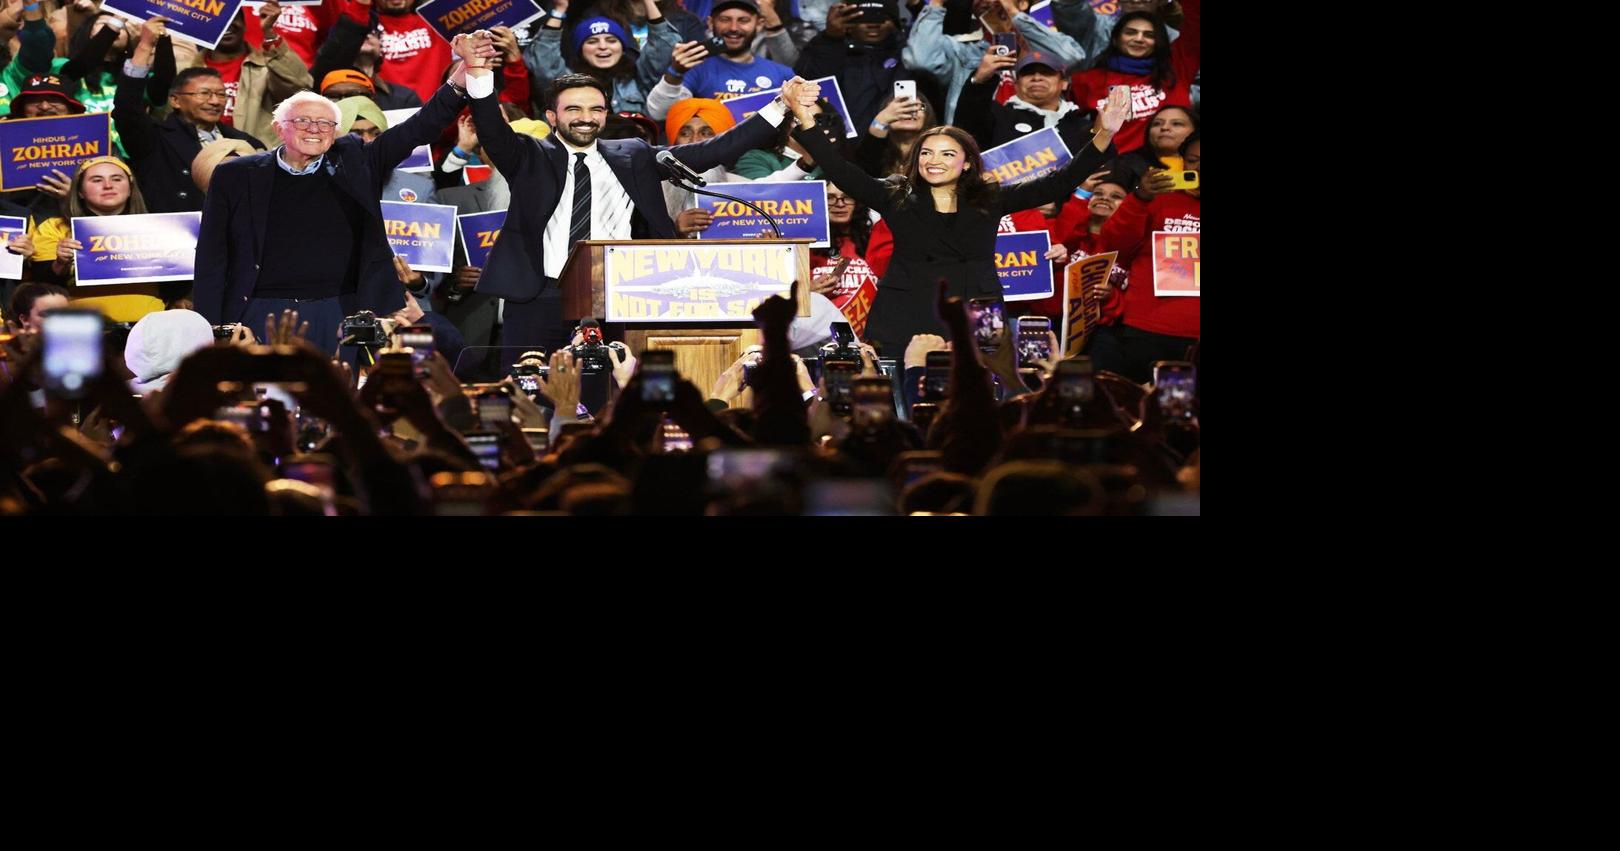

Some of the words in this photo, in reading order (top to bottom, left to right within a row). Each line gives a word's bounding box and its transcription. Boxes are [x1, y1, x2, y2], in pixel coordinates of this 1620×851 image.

[167, 2, 191, 16] YORK
[191, 11, 212, 23] CITY
[438, 0, 500, 30] ZOHRA
[495, 1, 513, 13] CITY
[12, 140, 99, 162] ZOHRAN
[29, 161, 50, 169] NEW
[52, 159, 76, 167] YORK
[732, 218, 756, 227] NEW
[786, 217, 809, 225] CITY
[411, 239, 434, 249] CITY
[612, 249, 690, 285] NEW
[693, 249, 790, 285] YORK
[1011, 269, 1034, 277] CITY
[612, 291, 661, 318] NOT
[669, 301, 720, 318] FOR
